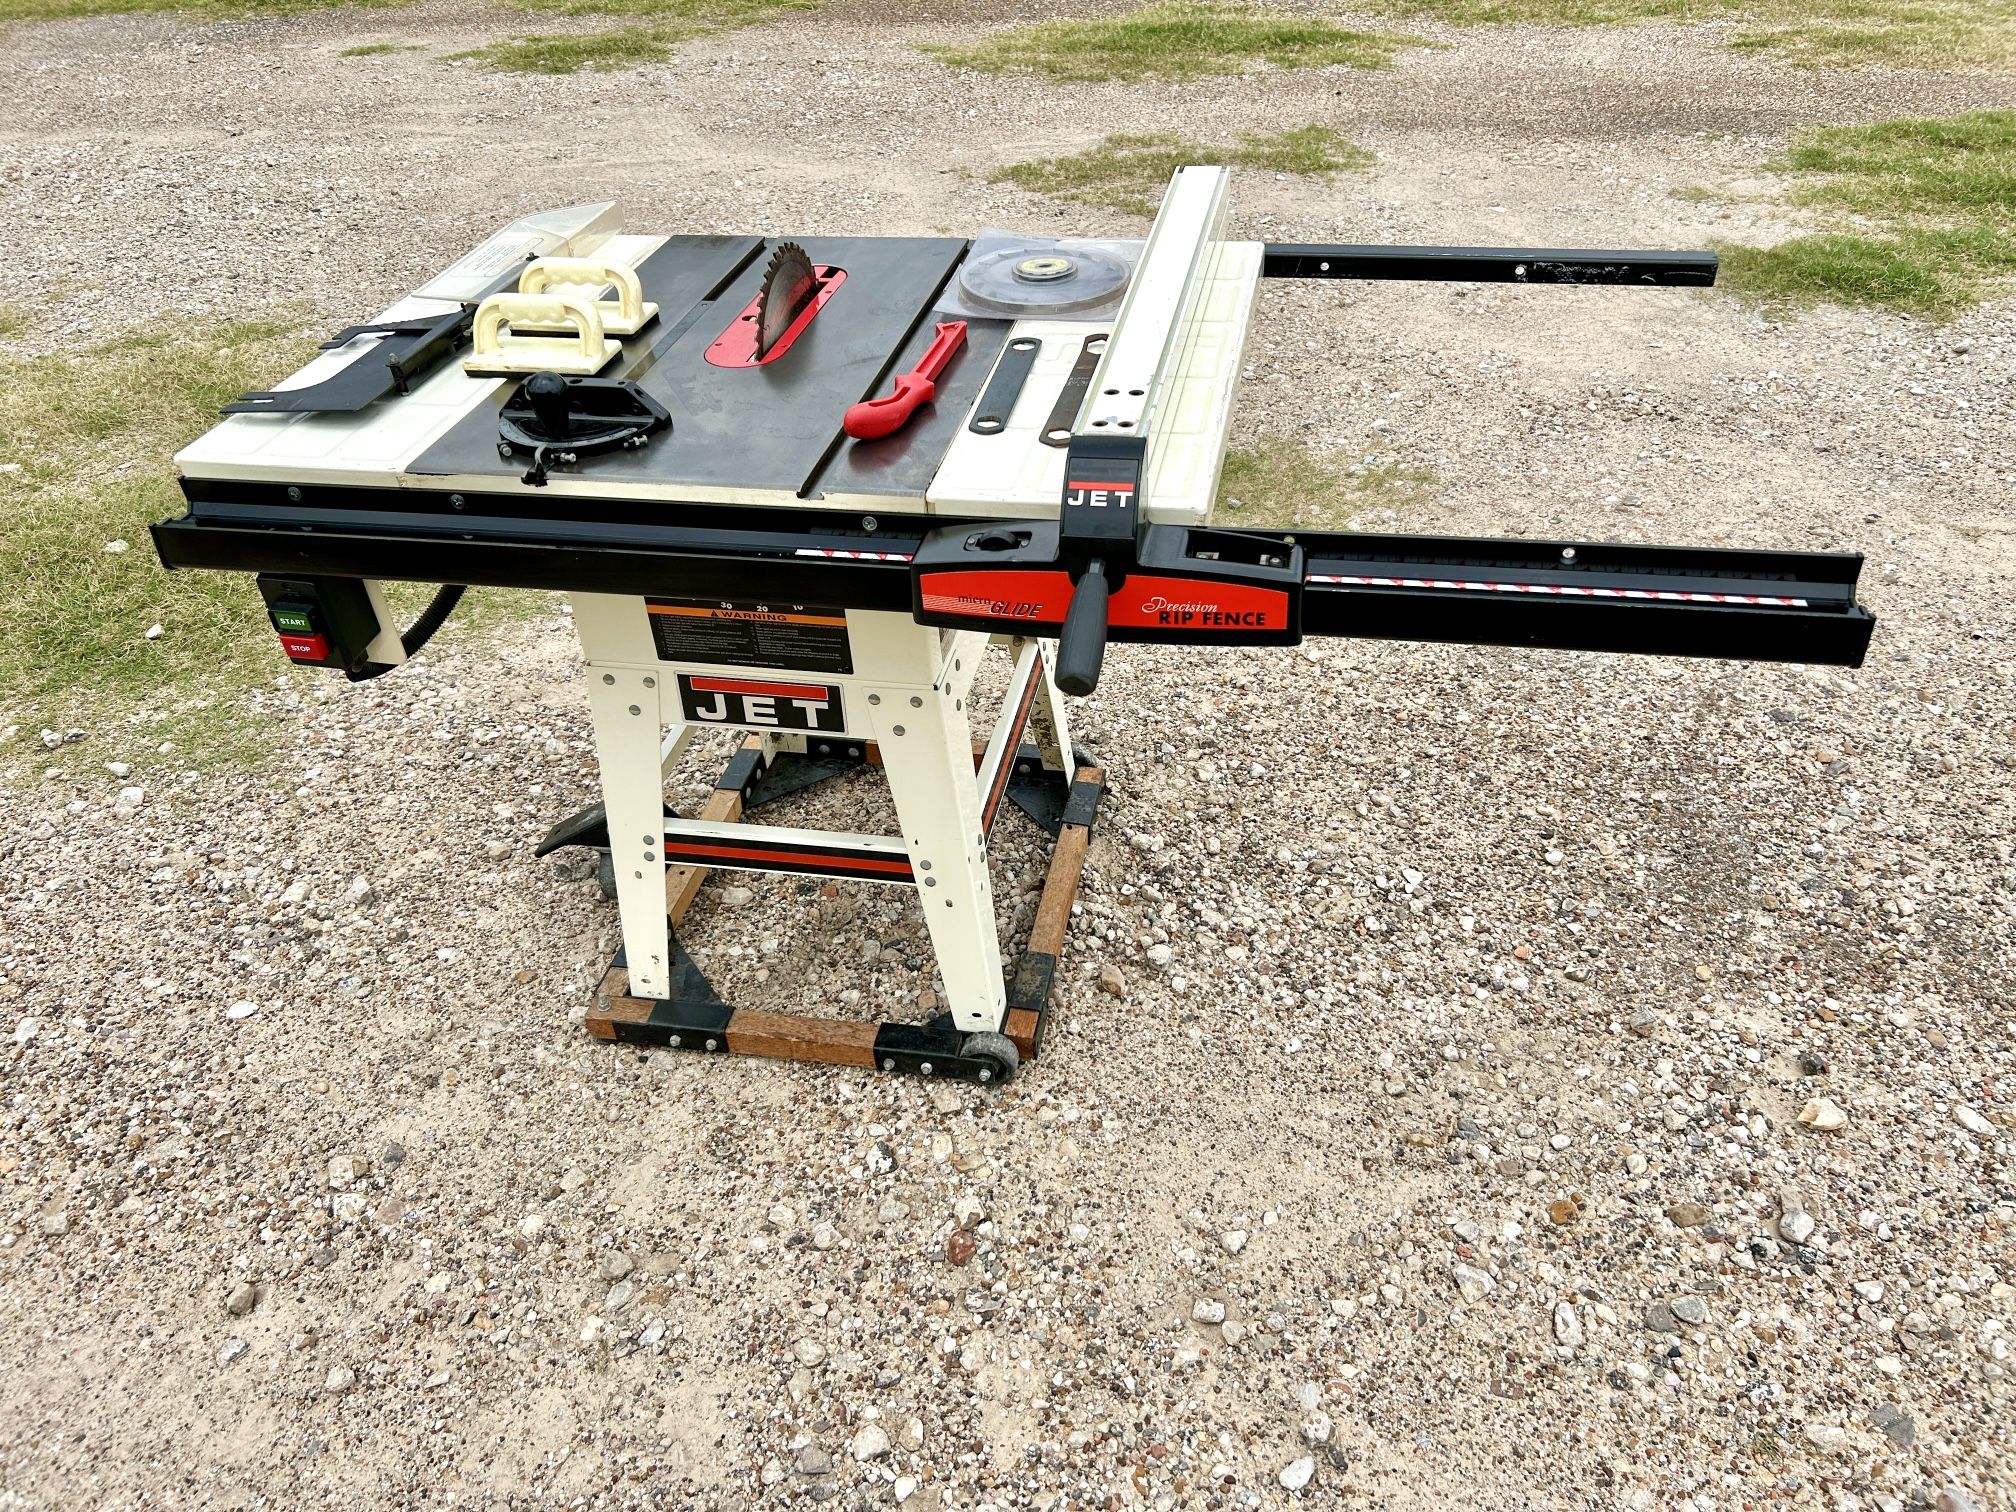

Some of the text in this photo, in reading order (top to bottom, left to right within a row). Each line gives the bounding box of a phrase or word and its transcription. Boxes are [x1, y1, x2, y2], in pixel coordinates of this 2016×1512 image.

[1067, 490, 1134, 508] JET
[721, 601, 732, 610] 30
[756, 605, 769, 613] 20
[990, 600, 1043, 618] GLIDE
[1141, 596, 1218, 613] Precision
[279, 618, 305, 626] START
[721, 611, 787, 621] WARNING
[1158, 611, 1266, 626] RIP FENCE
[695, 693, 829, 728] JET
